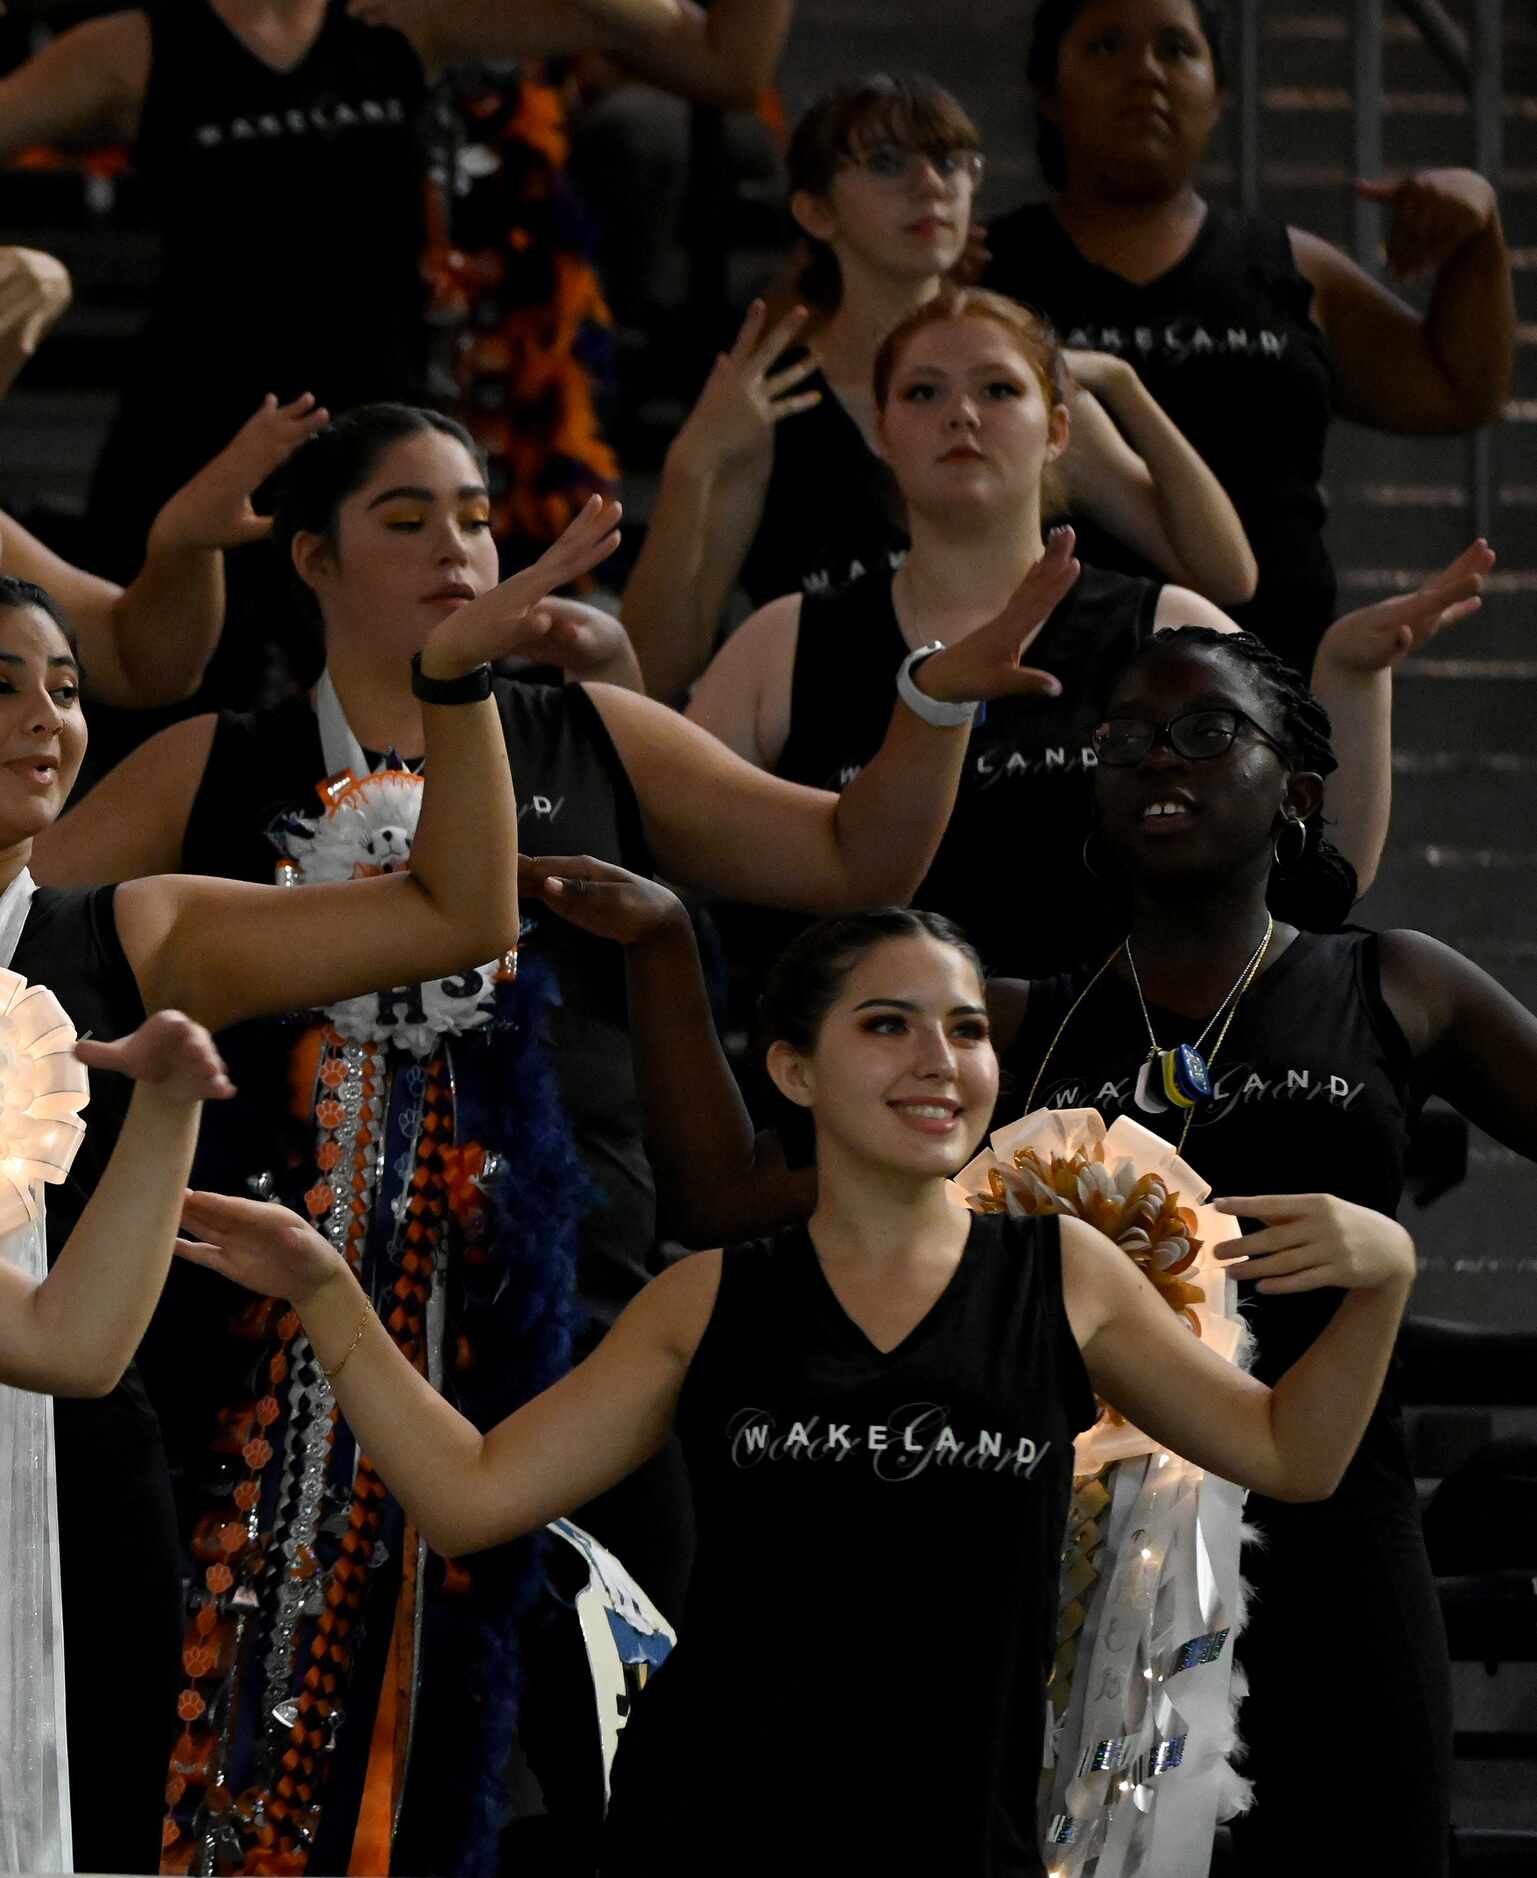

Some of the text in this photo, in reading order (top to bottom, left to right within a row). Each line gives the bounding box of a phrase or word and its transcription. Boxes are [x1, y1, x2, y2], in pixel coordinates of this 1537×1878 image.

[1064, 324, 1288, 360] AKELAND
[1054, 1068, 1352, 1107] WALAND
[744, 1421, 1037, 1465] WAKELAND
